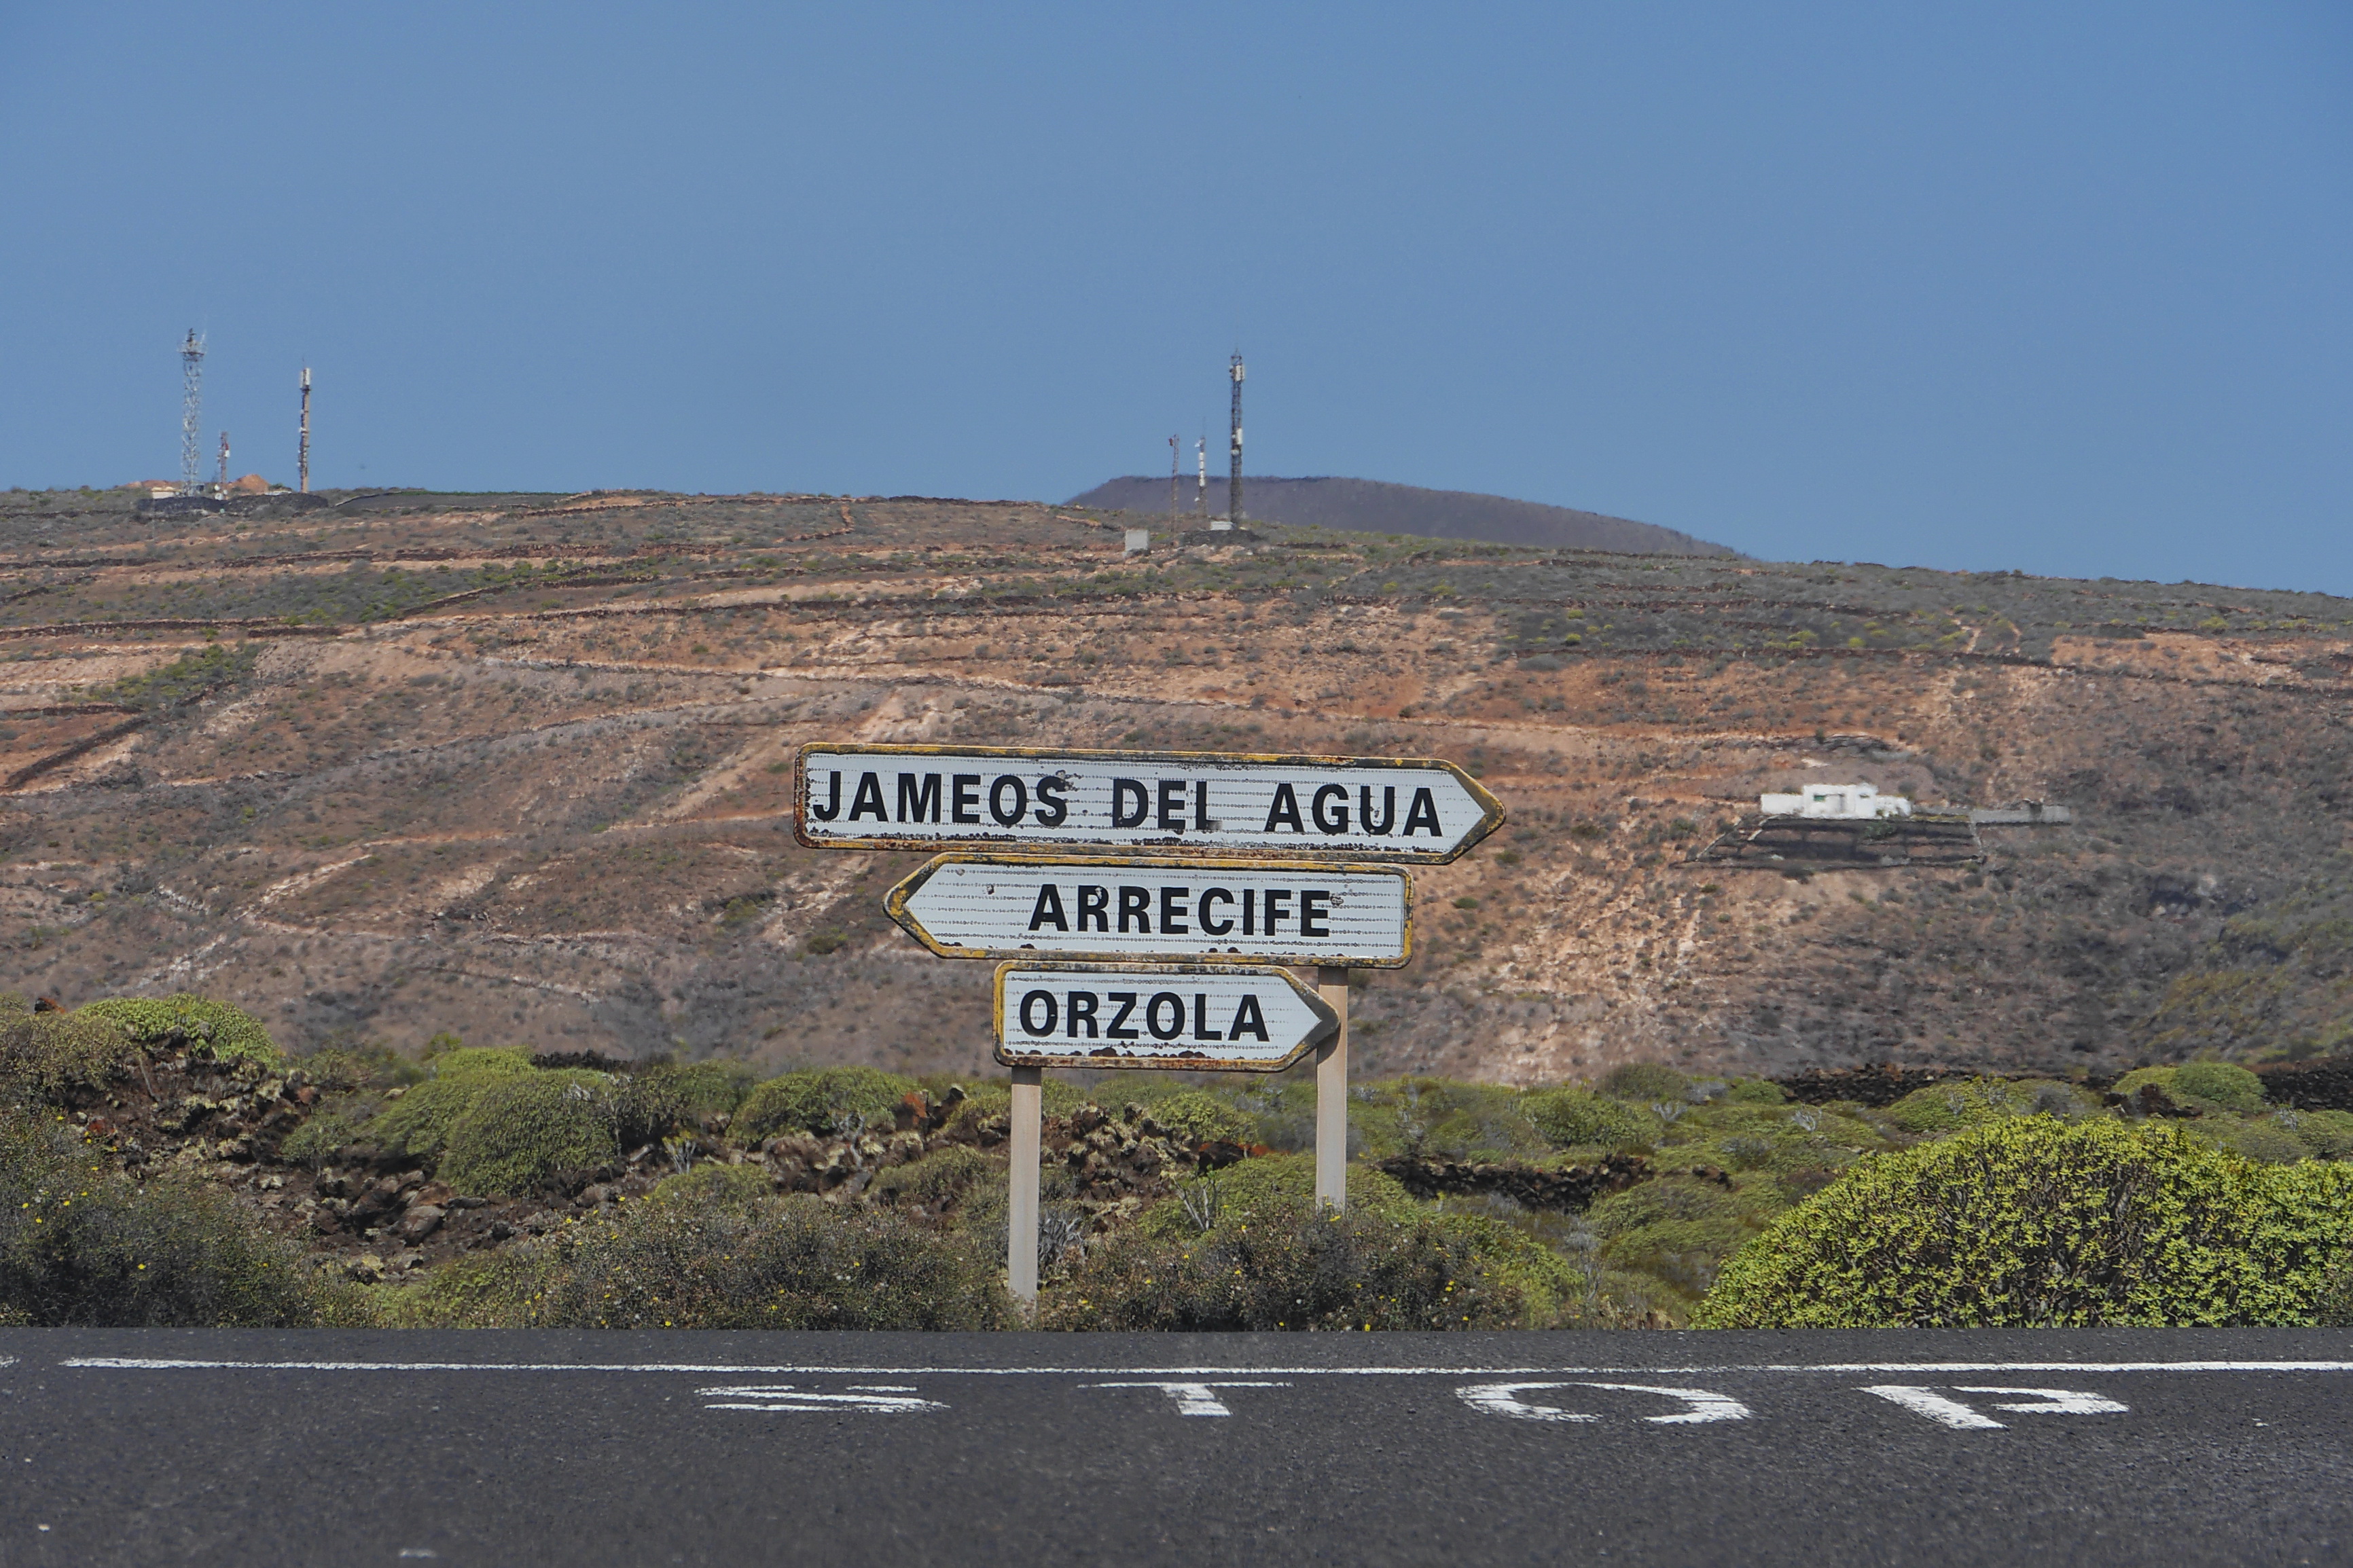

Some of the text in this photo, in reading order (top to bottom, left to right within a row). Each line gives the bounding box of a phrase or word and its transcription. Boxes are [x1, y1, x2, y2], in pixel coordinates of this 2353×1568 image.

[812, 770, 1443, 837] JAMEOS DEL AGUA
[1028, 883, 1331, 938] ARRECIFE
[1019, 989, 1270, 1042] ORZOLA
[694, 1381, 2130, 1429] STOP
